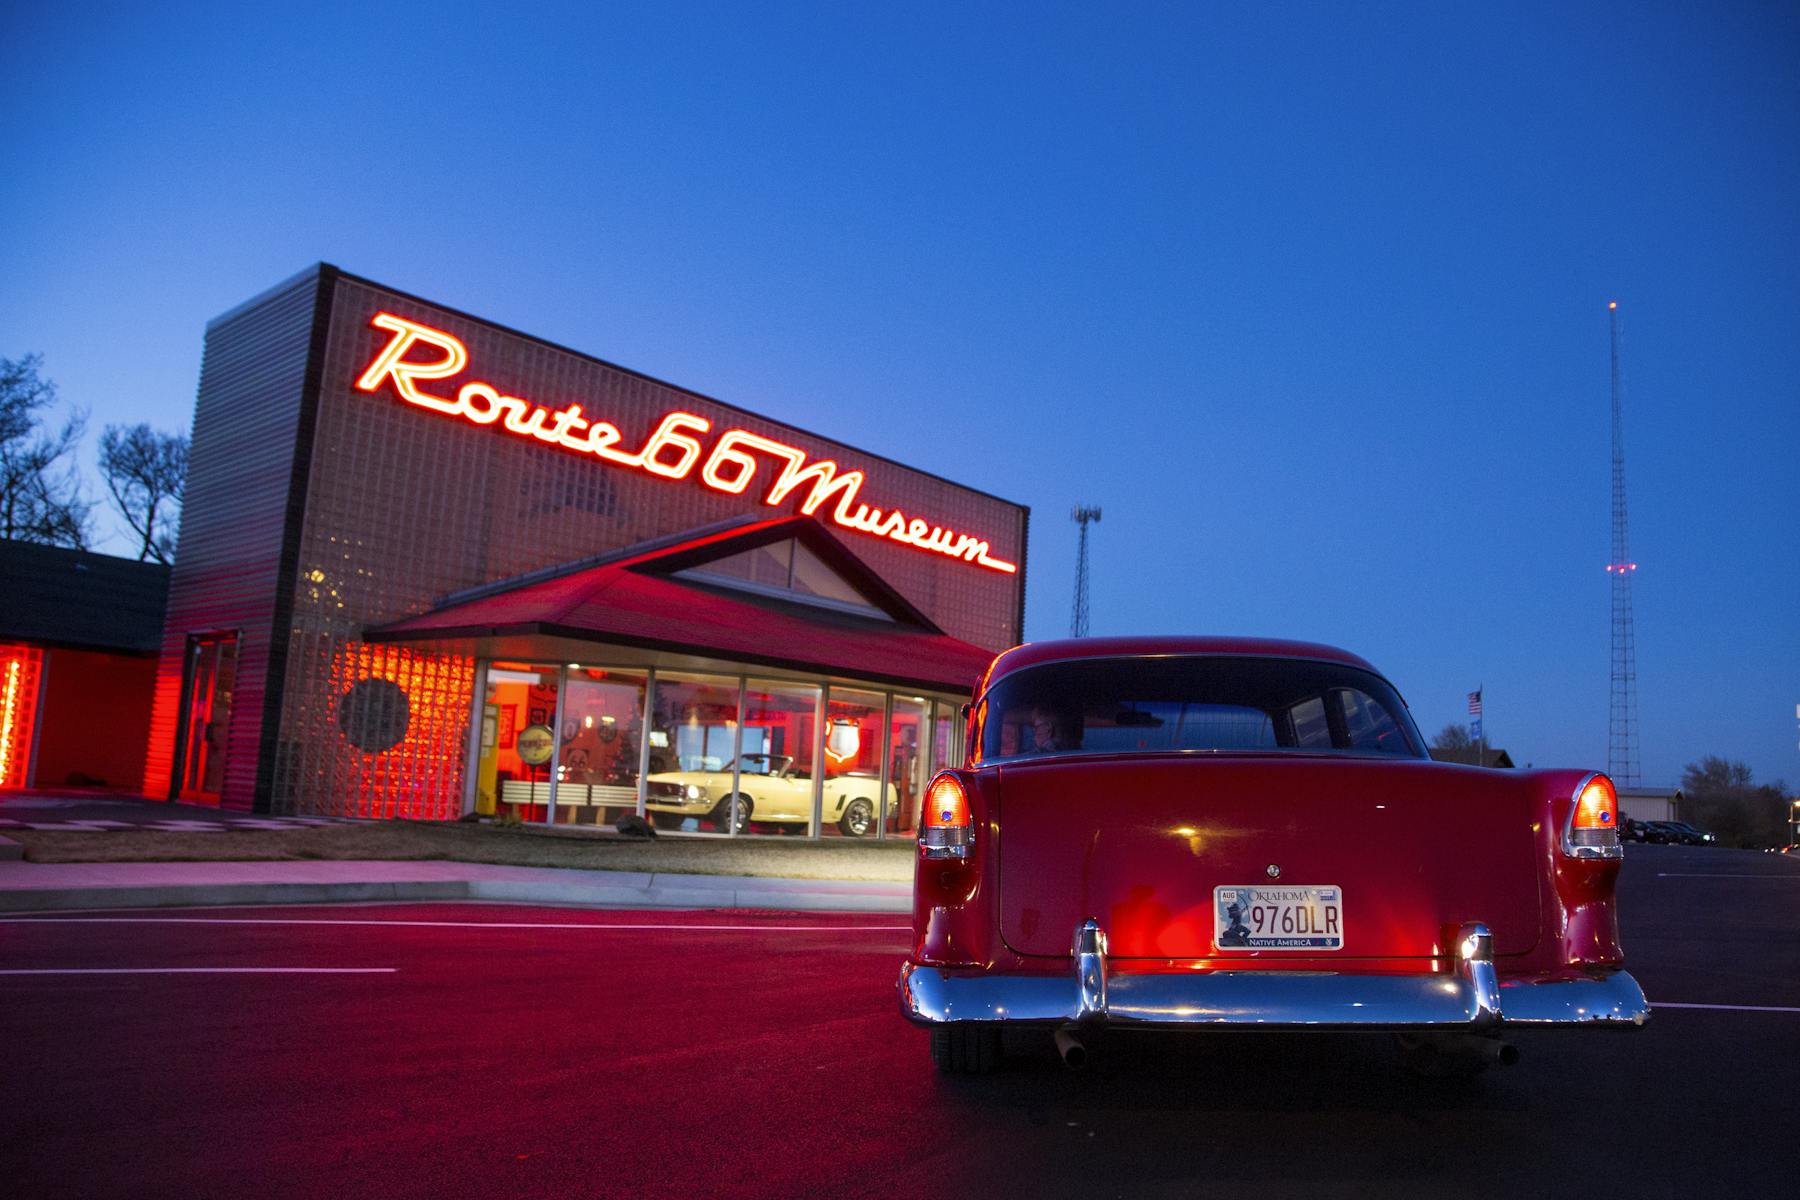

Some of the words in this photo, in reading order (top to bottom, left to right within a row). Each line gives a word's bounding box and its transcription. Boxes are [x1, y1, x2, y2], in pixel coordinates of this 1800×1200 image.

[356, 311, 642, 466] Route
[640, 411, 759, 495] 66
[766, 446, 1017, 573] Museum
[1222, 892, 1235, 900] AUG
[1248, 890, 1310, 904] OKLAHOMA
[1252, 905, 1338, 934] 976DLR
